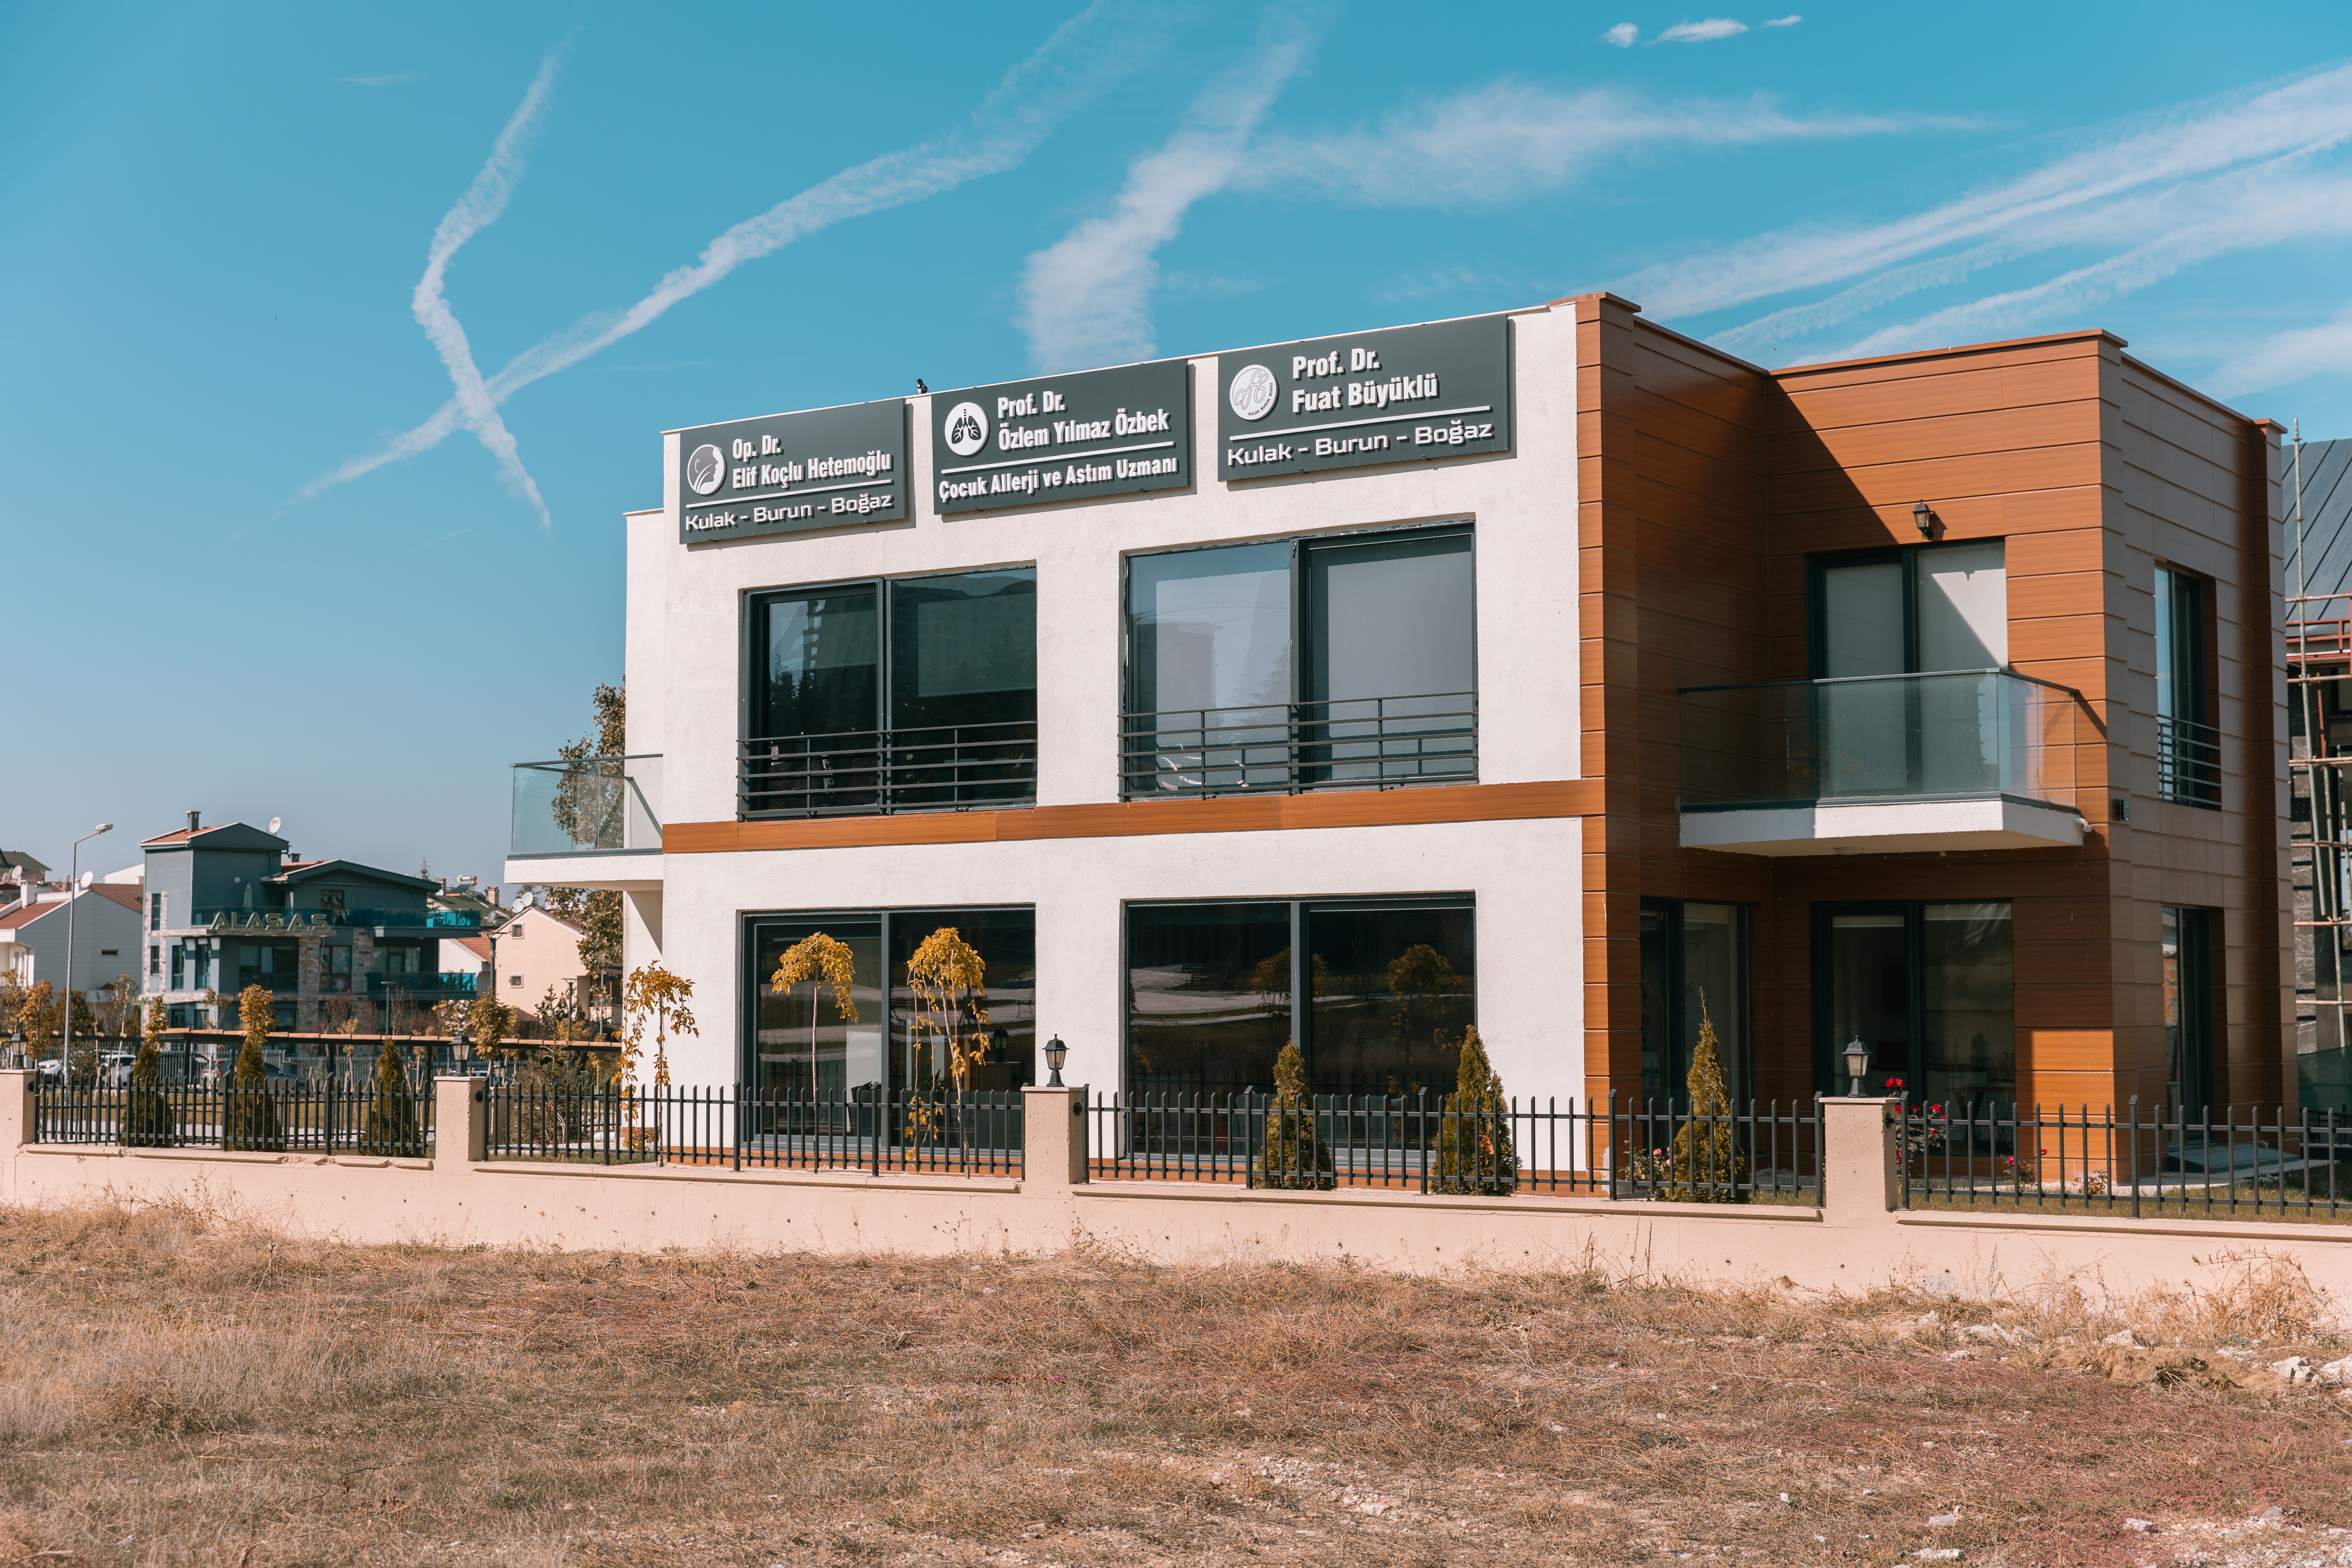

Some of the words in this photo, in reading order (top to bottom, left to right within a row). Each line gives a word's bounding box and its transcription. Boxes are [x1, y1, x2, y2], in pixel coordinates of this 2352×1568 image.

[1293, 351, 1344, 379] Prof.
[1352, 348, 1380, 371] Dr.
[998, 393, 1038, 418] Prof.
[1043, 391, 1066, 412] Dr.
[1260, 398, 1270, 411] BURUN
[1293, 386, 1342, 413] Fuat
[1349, 373, 1438, 408] Büyüklü
[733, 438, 758, 462] Op.
[762, 435, 782, 455] Dr.
[999, 422, 1050, 451] Özlem
[1053, 420, 1111, 444] Yılmaz
[1115, 408, 1170, 436] Özbek
[1228, 443, 1293, 466] Kulak
[1316, 435, 1389, 456] Burun
[1415, 420, 1493, 445] Boğaz
[733, 466, 758, 488] Elif
[762, 461, 804, 488] Koçlu
[808, 450, 892, 479] Hetemoğlu
[939, 477, 988, 503] Çocuk
[991, 470, 1039, 495] Allerji
[1042, 471, 1062, 487] ve
[1066, 464, 1113, 485] Astım
[1116, 457, 1178, 479] Uzmanı
[685, 512, 736, 531] Kulak
[754, 503, 813, 522] Burun
[832, 493, 892, 513] Boğaz
[210, 912, 282, 930] ALAS
